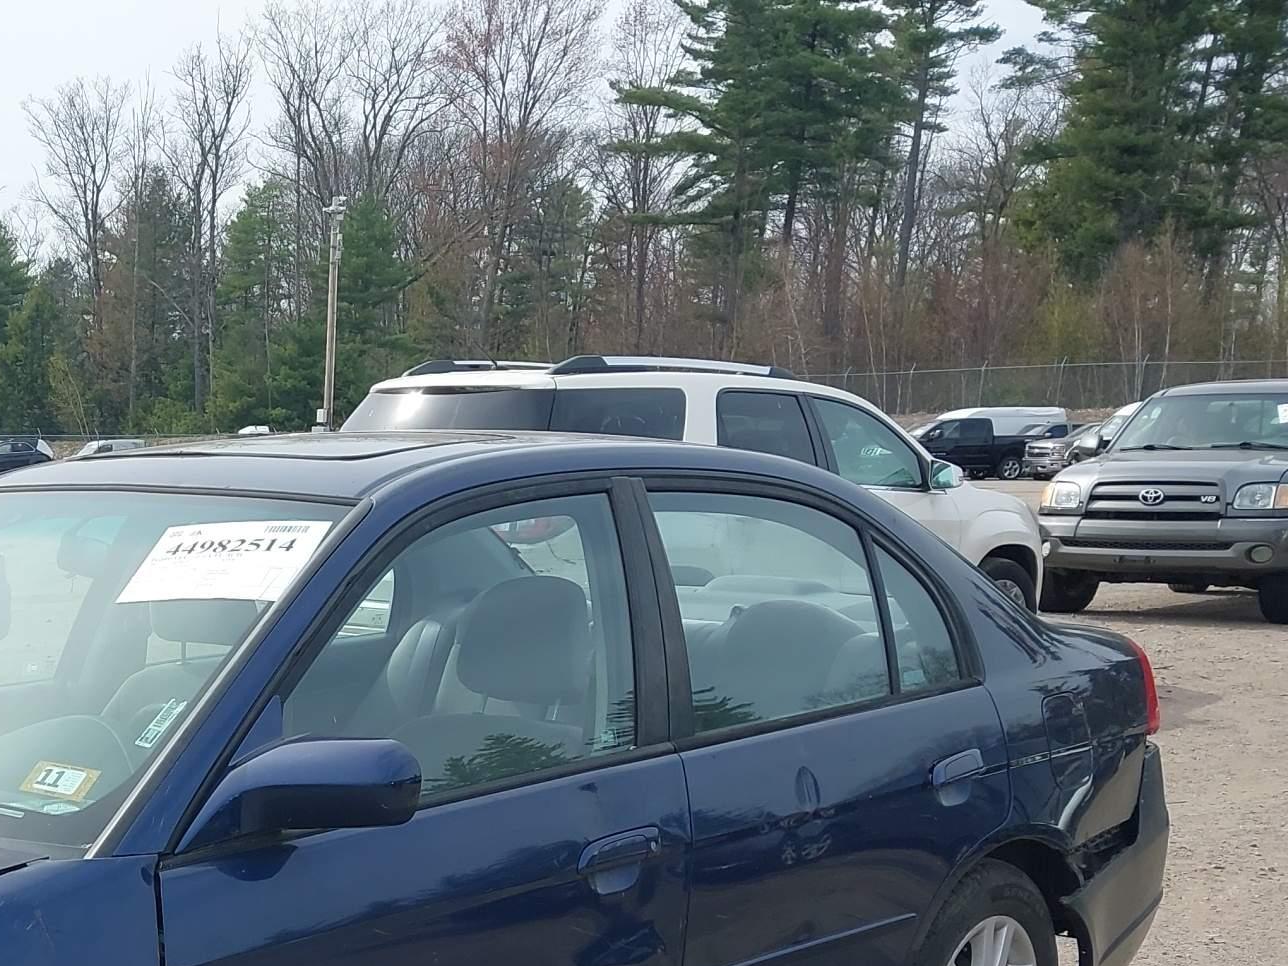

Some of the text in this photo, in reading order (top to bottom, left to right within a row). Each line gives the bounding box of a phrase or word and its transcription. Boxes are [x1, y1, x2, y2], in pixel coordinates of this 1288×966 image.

[1200, 495, 1217, 503] V8
[166, 538, 297, 556] 44982514
[34, 768, 66, 788] 11
